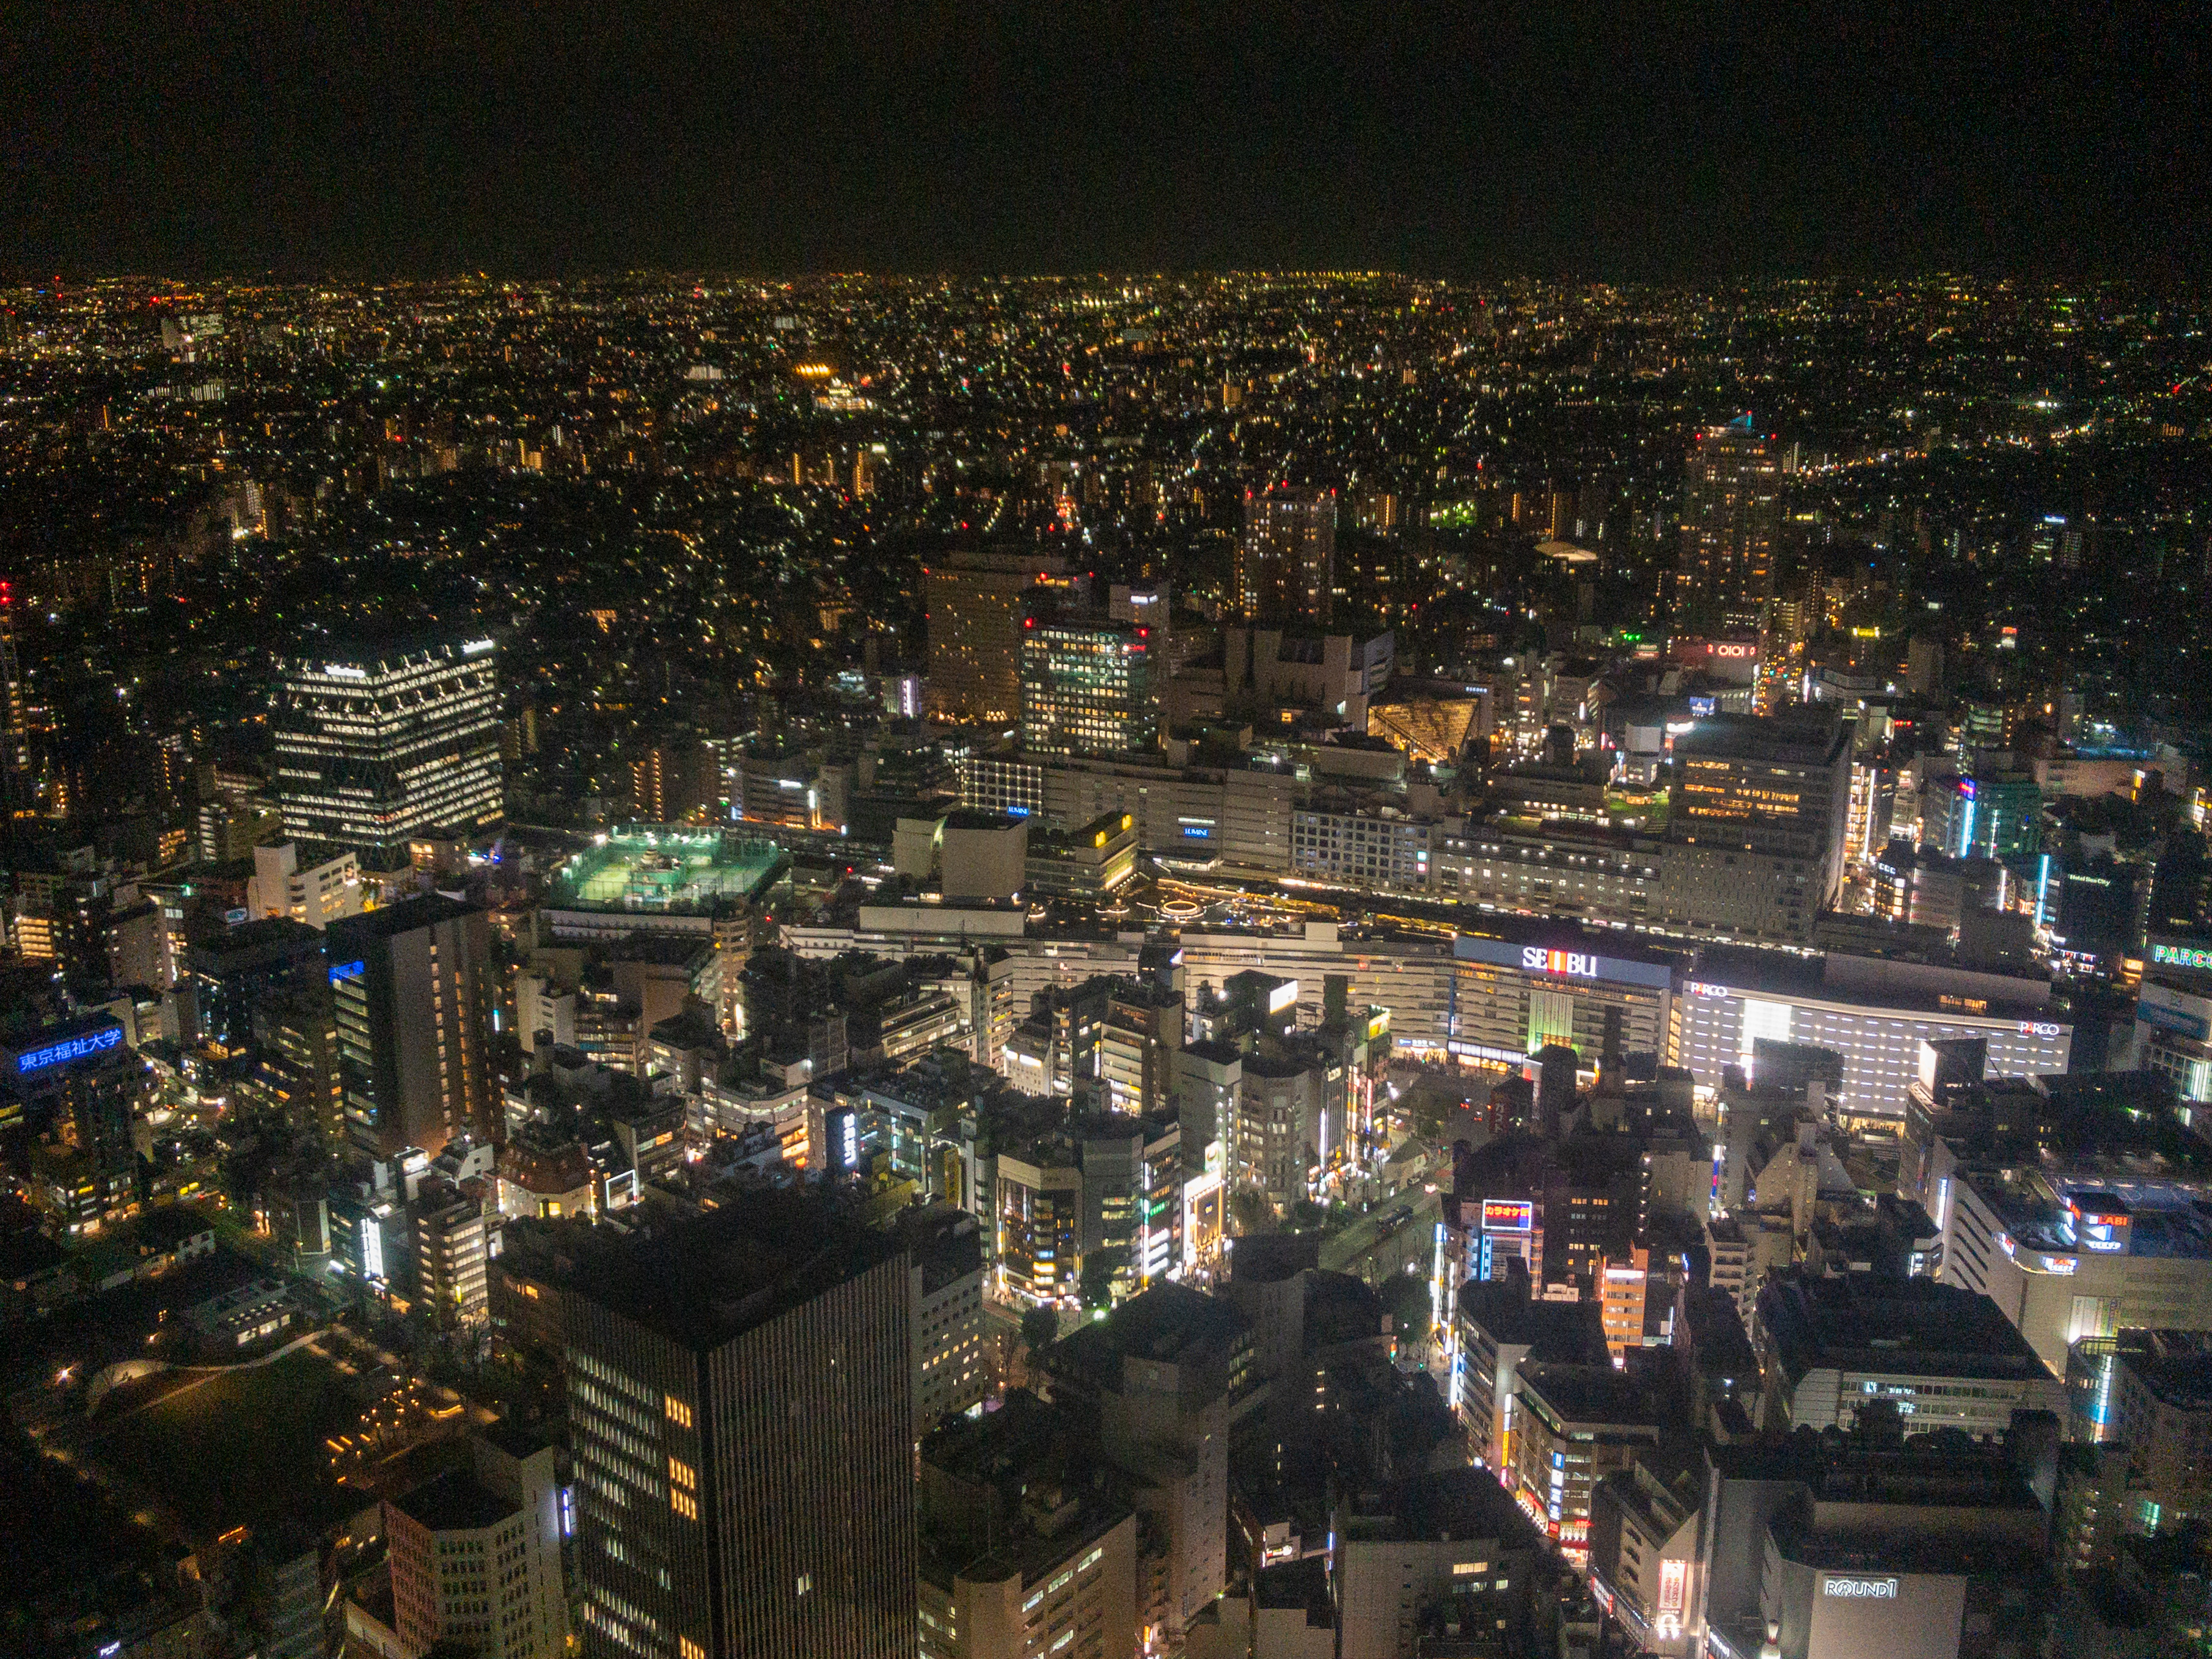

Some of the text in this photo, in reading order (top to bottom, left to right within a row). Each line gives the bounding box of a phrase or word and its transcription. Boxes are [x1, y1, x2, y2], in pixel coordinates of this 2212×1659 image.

[1522, 947, 1597, 977] SEIBU
[1690, 982, 1728, 997] PARCO
[2020, 1021, 2059, 1036] PARCO
[19, 1028, 122, 1073] 東京福祉大学
[2098, 1215, 2128, 1226] LABI
[1825, 1580, 1896, 1598] ROUND1
